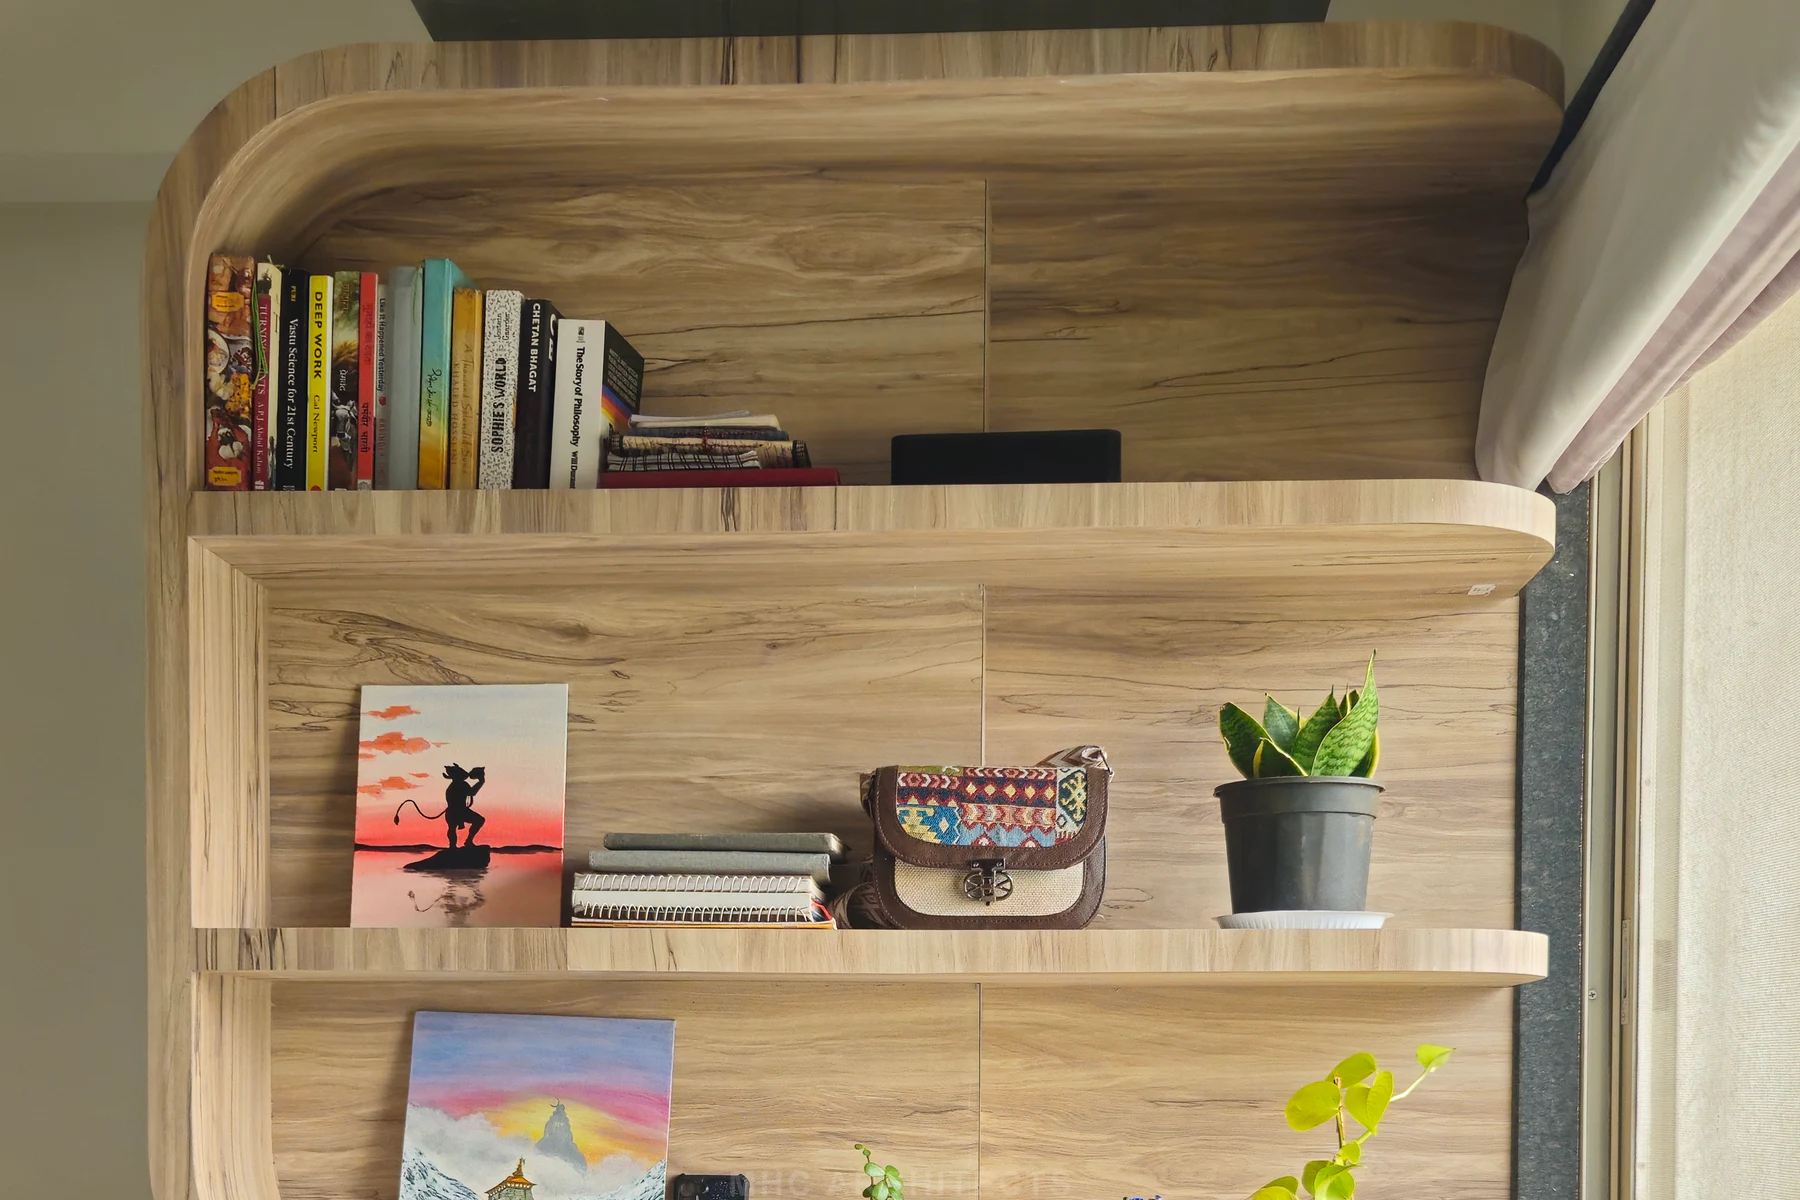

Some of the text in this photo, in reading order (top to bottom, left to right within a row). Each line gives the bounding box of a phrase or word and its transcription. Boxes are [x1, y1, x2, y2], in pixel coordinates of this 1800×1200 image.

[258, 304, 268, 351] TURNIN
[313, 291, 323, 379] DEEP WORK
[377, 321, 386, 357] Happened
[528, 303, 541, 393] CHETAN BHAGAT
[377, 358, 385, 392] Yesterday
[573, 363, 584, 387] Story
[575, 346, 585, 363] The
[283, 318, 299, 469] Vastu Science for 21st Century
[452, 363, 460, 408] KHALED
[494, 357, 507, 399] WORLD
[574, 387, 583, 396] of
[256, 425, 264, 448] Abdul
[311, 412, 320, 453] Newport
[570, 398, 583, 447] Philosophy
[255, 450, 264, 474] Kalam
